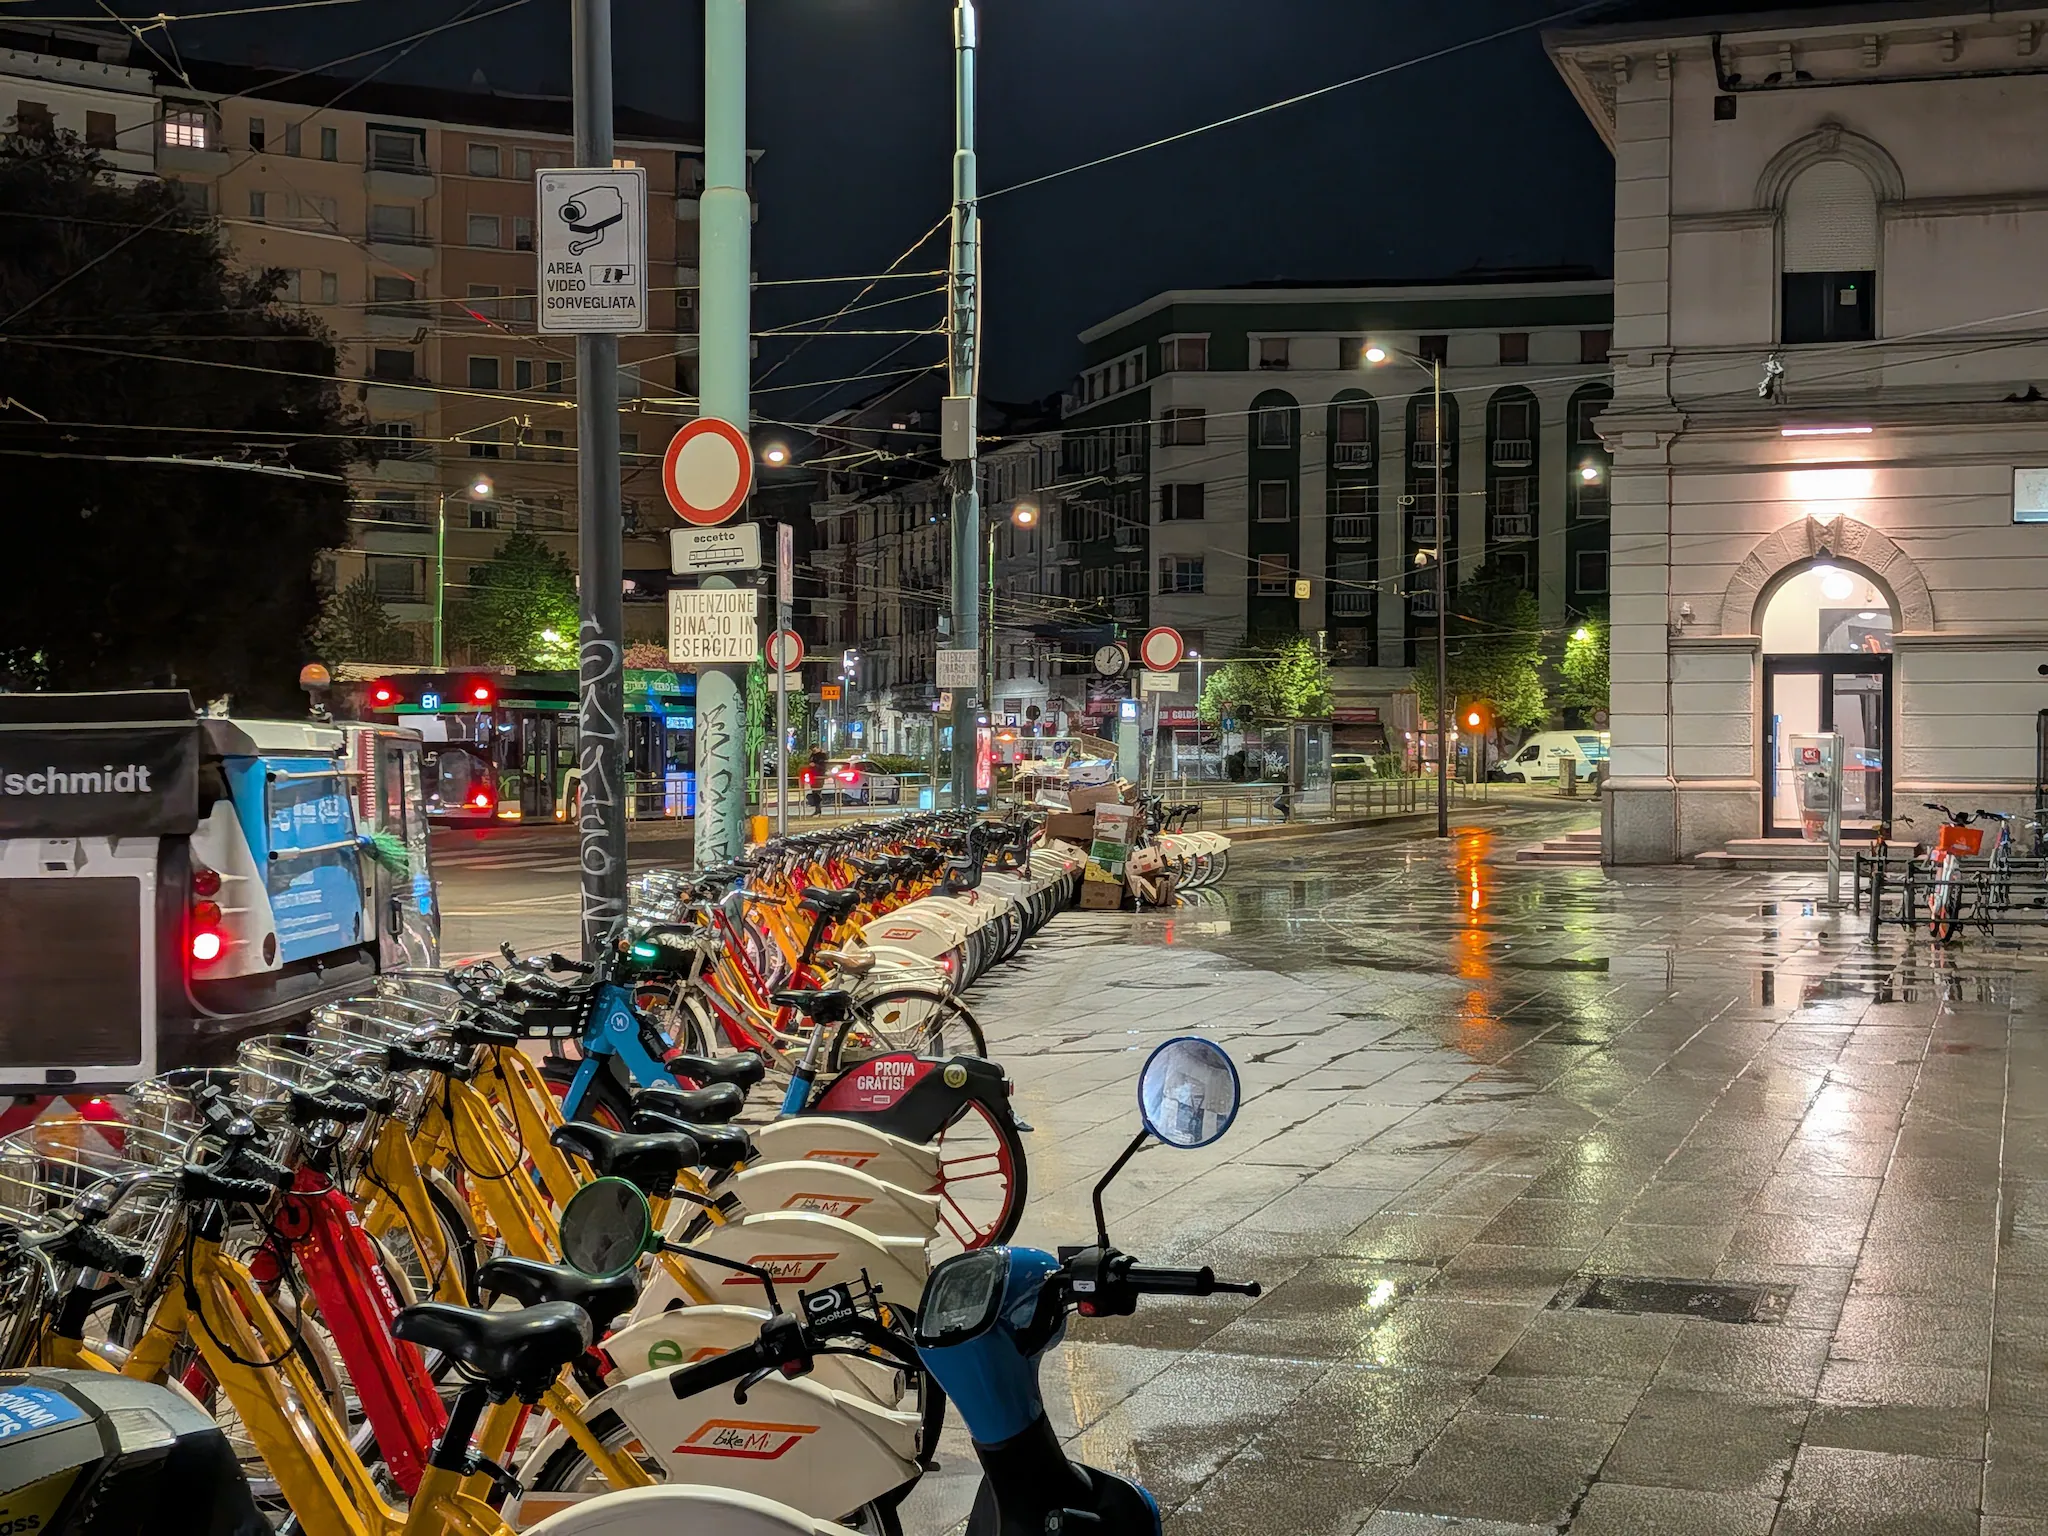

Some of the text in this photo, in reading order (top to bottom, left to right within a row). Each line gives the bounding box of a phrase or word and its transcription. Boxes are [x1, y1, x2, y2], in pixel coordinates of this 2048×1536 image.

[547, 262, 583, 275] AREA
[547, 279, 586, 292] VIDEO
[547, 296, 636, 309] SORVEGLIATA
[693, 532, 736, 543] eccetto
[674, 594, 754, 613] ATTENZIONE
[673, 616, 753, 636] BINAIO IN
[673, 638, 753, 657] ESERCIZIO
[422, 694, 438, 709] 81
[874, 1061, 915, 1077] PROVA
[857, 1075, 905, 1091] GRATIS!
[814, 1307, 853, 1326] cooltra
[712, 1428, 772, 1451] bikeMi
